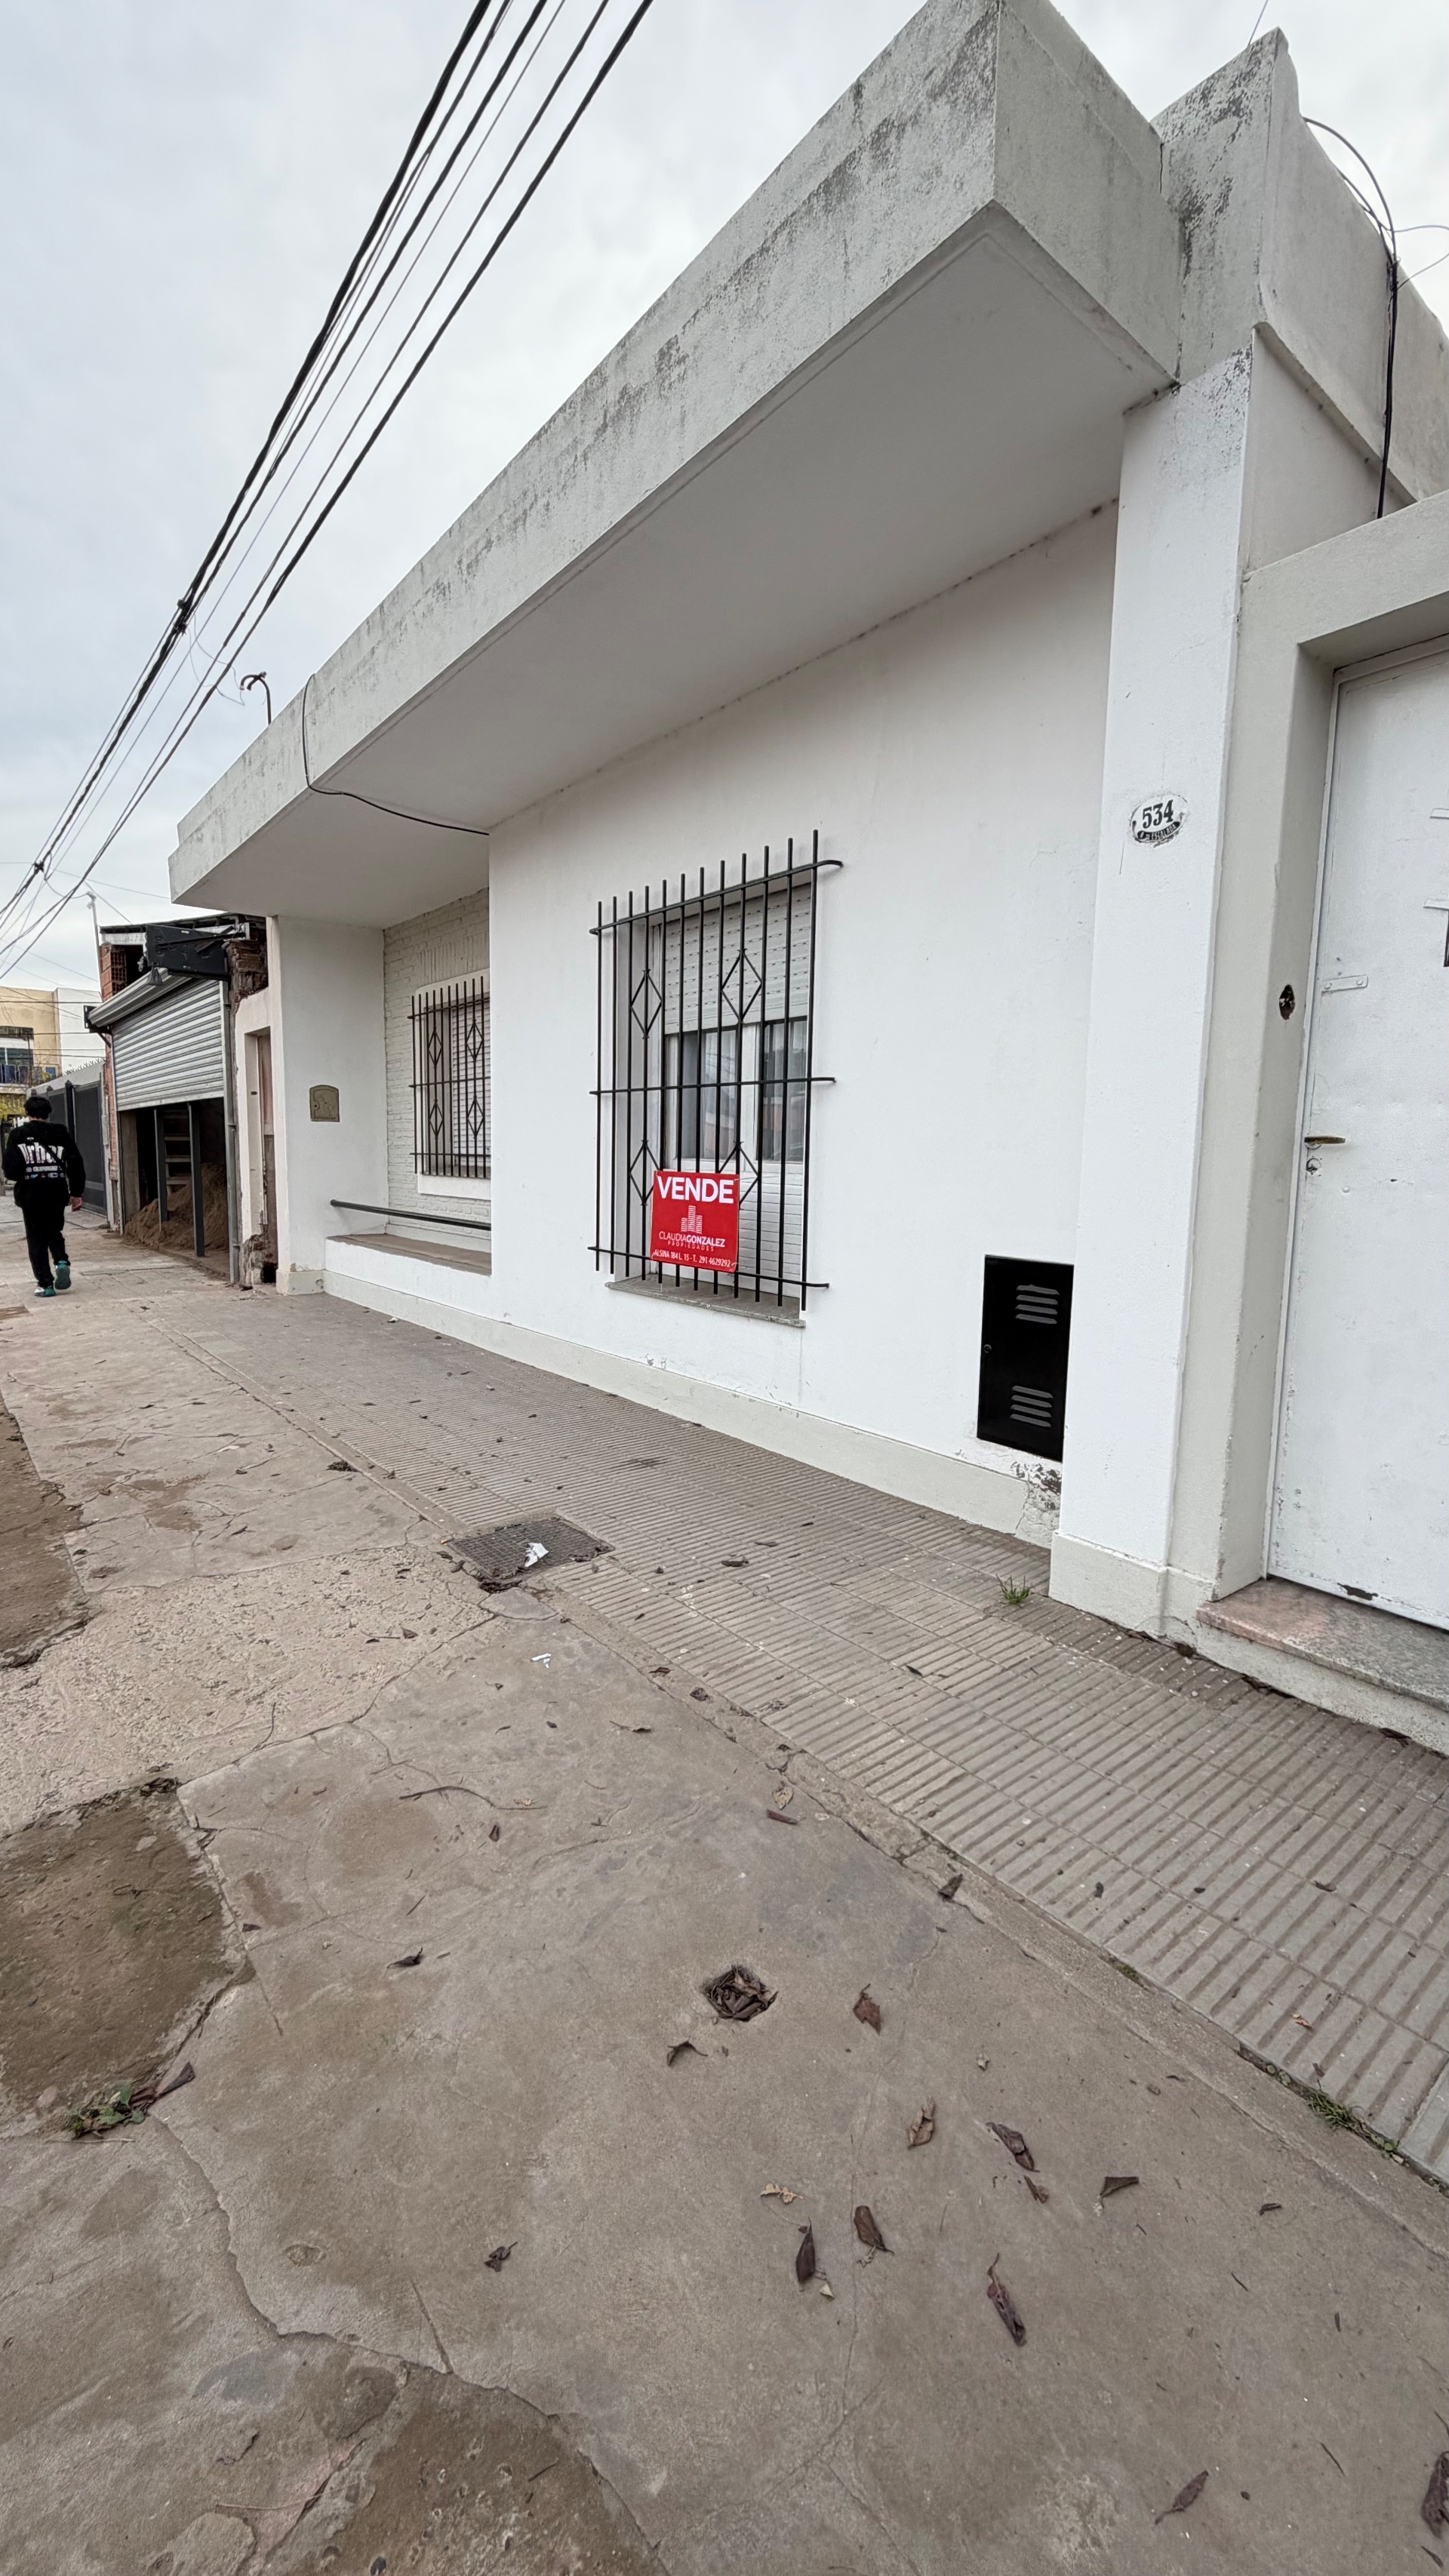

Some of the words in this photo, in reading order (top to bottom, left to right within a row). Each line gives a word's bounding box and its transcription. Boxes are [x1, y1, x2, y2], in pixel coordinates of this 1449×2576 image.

[1143, 799, 1174, 829] 534
[657, 1175, 734, 1204] VENDE
[654, 1249, 670, 1258] ALSINA
[684, 1253, 690, 1261] 15
[699, 1255, 708, 1264] 291
[668, 1241, 714, 1251] PROPIEDADES
